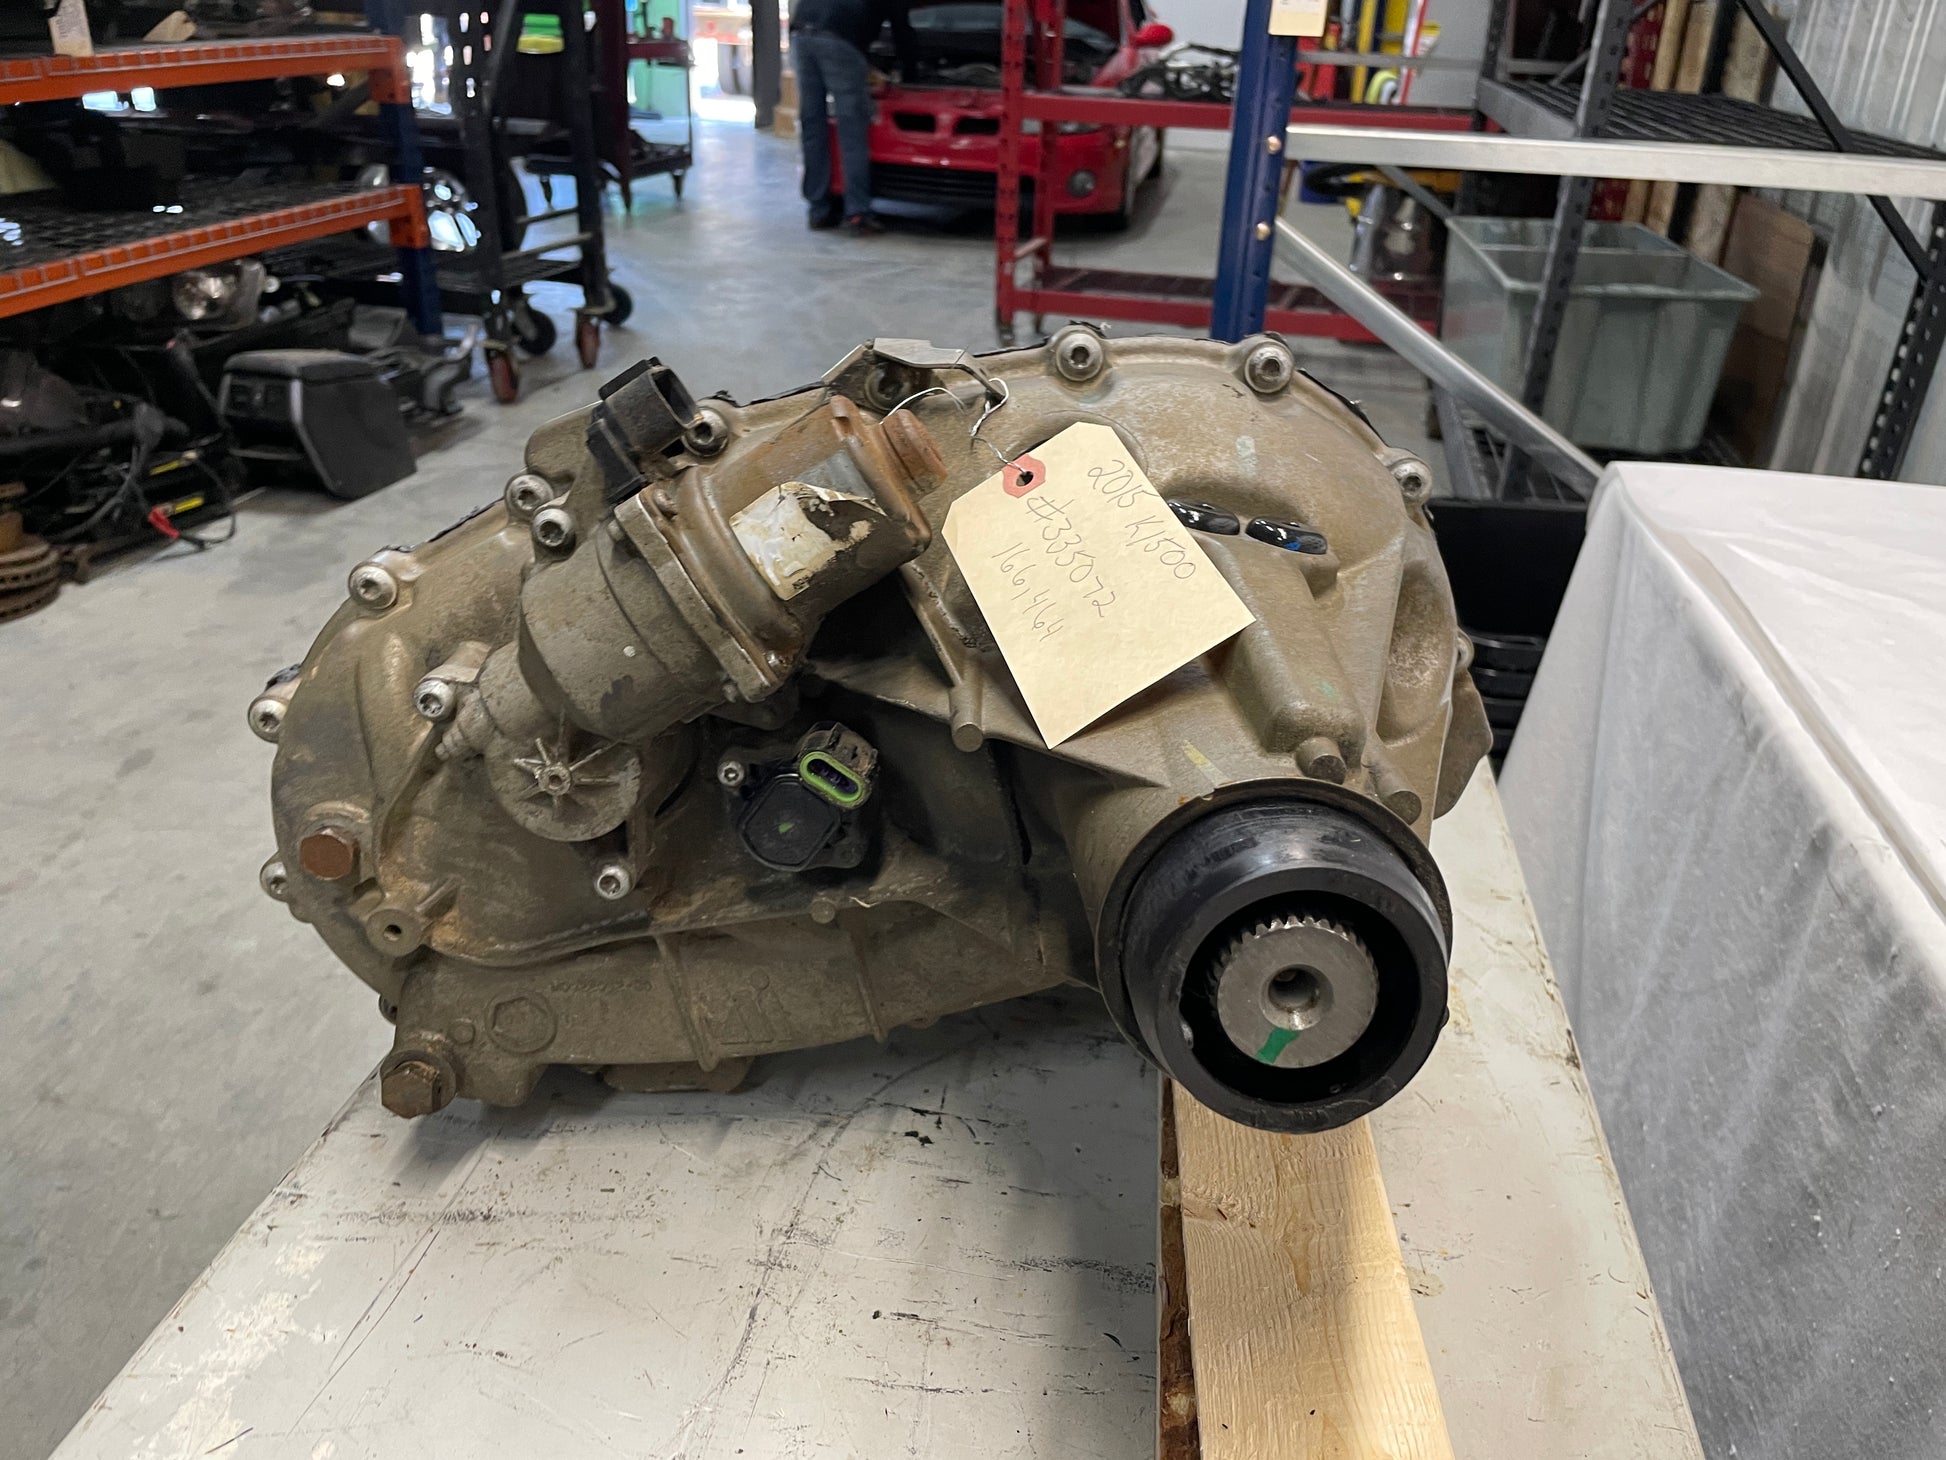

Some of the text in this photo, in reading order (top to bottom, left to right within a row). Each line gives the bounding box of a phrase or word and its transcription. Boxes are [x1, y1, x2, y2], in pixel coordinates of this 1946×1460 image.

[1026, 496, 1116, 618] #335072
[1088, 460, 1196, 579] 2015 K1500
[991, 542, 1064, 642] 166,464
